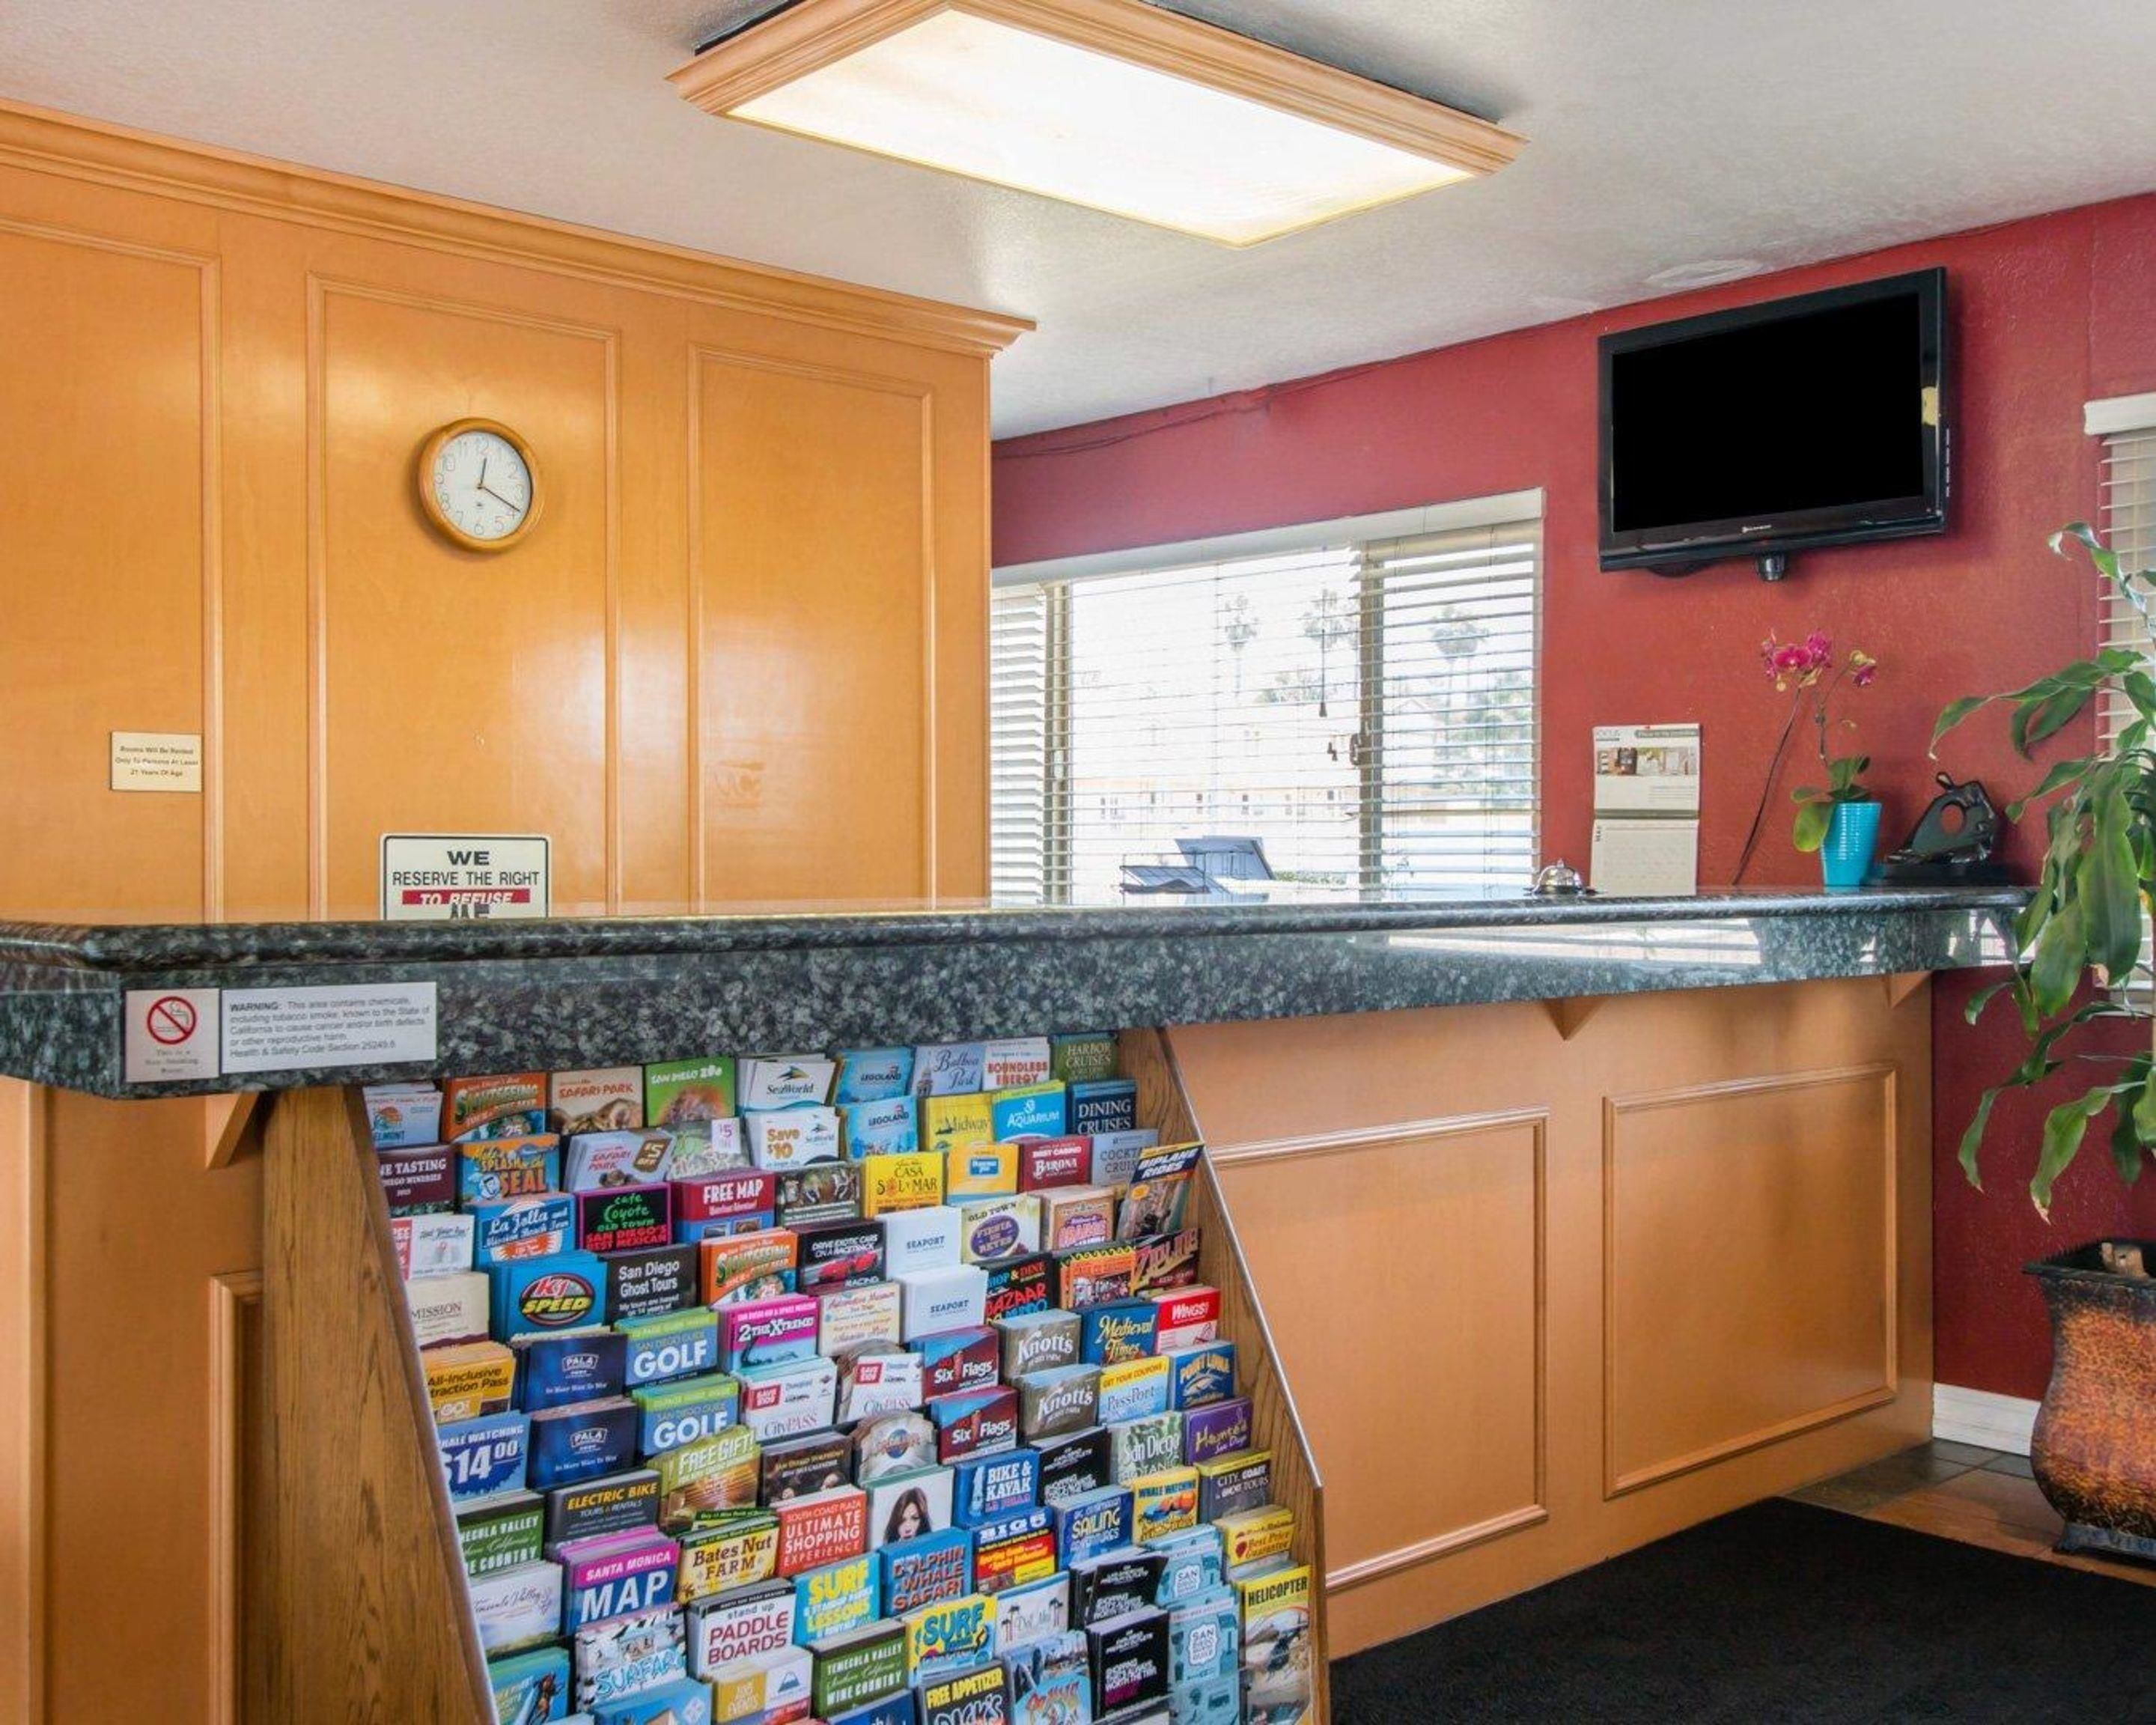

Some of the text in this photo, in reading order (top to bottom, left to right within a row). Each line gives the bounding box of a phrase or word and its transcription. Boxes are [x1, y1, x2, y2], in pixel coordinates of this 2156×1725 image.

[447, 851, 490, 865] WE
[392, 871, 540, 886] RESERVE THE RIGHT
[449, 892, 514, 904] REFUSE
[861, 1072, 902, 1083] LEGOLAND
[987, 1061, 1047, 1074] BOUNDLESS
[559, 1083, 633, 1099] SAFARI PARK
[767, 1083, 814, 1095] SeaWorld
[868, 1111, 910, 1127] LEGOLAND
[1007, 1110, 1060, 1128] AQUARIUM
[1078, 1098, 1132, 1119] DINING
[767, 1128, 800, 1143] Save
[1077, 1117, 1132, 1135] CRUISES
[395, 1158, 446, 1175] TASTING
[895, 1167, 924, 1178] CASA
[501, 1169, 547, 1198] SEAL
[704, 1178, 764, 1205] FREE MAP
[914, 1177, 937, 1192] MAR
[489, 1219, 509, 1235] La
[513, 1211, 548, 1233] Jolla
[603, 1205, 650, 1222] Coyote
[907, 1235, 945, 1250] SEAPORT
[619, 1260, 680, 1281] San Diego
[620, 1277, 678, 1297] Ghost Tours
[412, 1301, 463, 1319] MISSION
[522, 1297, 592, 1315] SPEED
[931, 1300, 969, 1313] SEAPORT
[634, 1339, 707, 1378] GOLF
[1017, 1330, 1074, 1365] Knott's
[565, 1356, 594, 1368] PALA
[934, 1360, 993, 1384] Six Flags
[428, 1367, 502, 1387] All-Inclusive
[481, 1377, 509, 1389] Pass
[1037, 1387, 1094, 1421] Knott's
[468, 1424, 524, 1443] WATCHING
[575, 1431, 603, 1444] PALA
[654, 1410, 728, 1449] GOLF
[951, 1420, 1011, 1444] Six Flags
[678, 1446, 716, 1475] FREE
[987, 1461, 1032, 1483] BIKE &
[567, 1482, 657, 1511] ELECTRIC BIKE
[986, 1477, 1032, 1503] KAYAK
[499, 1515, 539, 1534] VALLEY
[787, 1510, 860, 1537] ULTIMATE
[1072, 1507, 1121, 1541] SAILING
[785, 1525, 860, 1554] SHOPPING
[480, 1545, 538, 1569] COUNTRY
[692, 1536, 773, 1568] Bates Nut
[785, 1540, 859, 1566] EXPERIENCE
[586, 1551, 672, 1582] SANTA MONICA
[706, 1554, 756, 1581] FARM
[903, 1560, 964, 1591] WHALE
[809, 1560, 869, 1604] SURF
[1248, 1575, 1308, 1607] HELICOPTER
[580, 1570, 669, 1624] MAP
[709, 1610, 789, 1646] PADDLE
[923, 1601, 985, 1646] SURF
[707, 1632, 787, 1665] BOARDS
[871, 1643, 903, 1661] VALLEY
[855, 1670, 903, 1697] COUNTRY
[926, 1667, 1004, 1709] FREE APPETIZER
